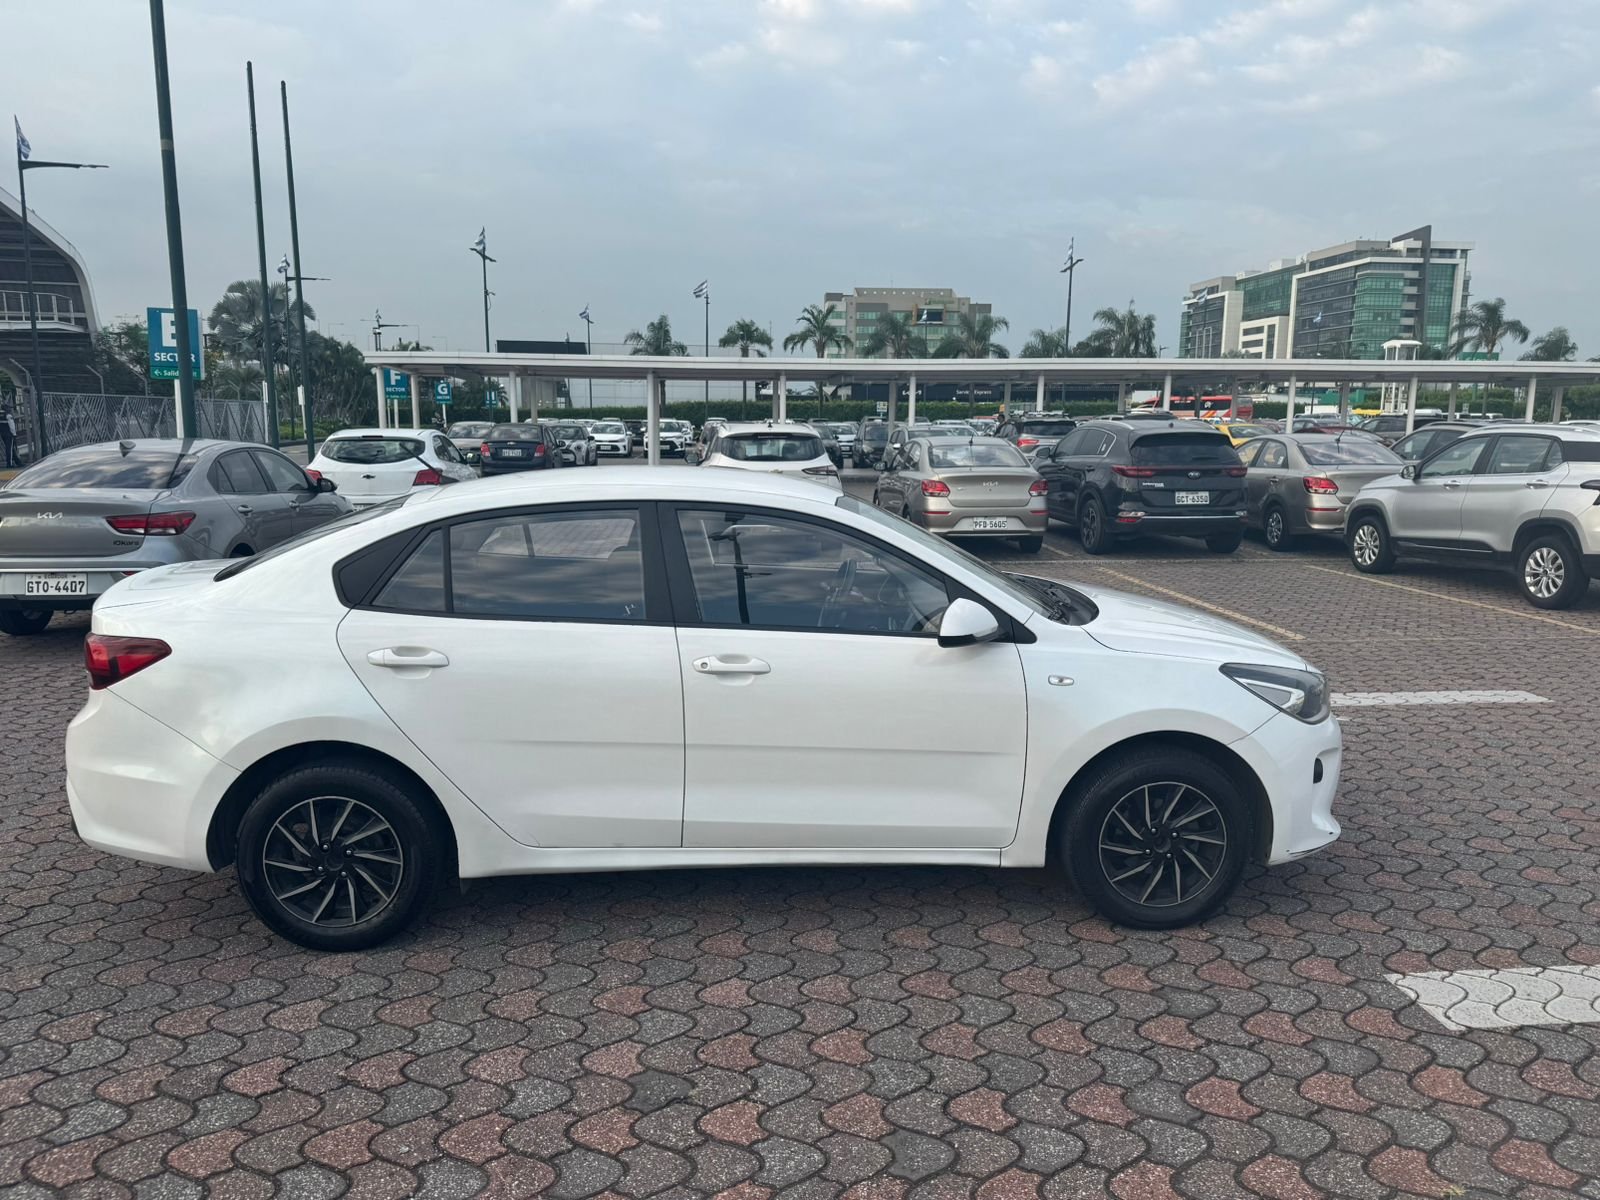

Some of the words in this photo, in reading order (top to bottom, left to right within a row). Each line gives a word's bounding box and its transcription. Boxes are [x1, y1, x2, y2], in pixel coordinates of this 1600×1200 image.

[154, 352, 195, 362] SECTR
[390, 370, 401, 385] F
[437, 383, 449, 395] G
[27, 581, 85, 593] GTO-4407
